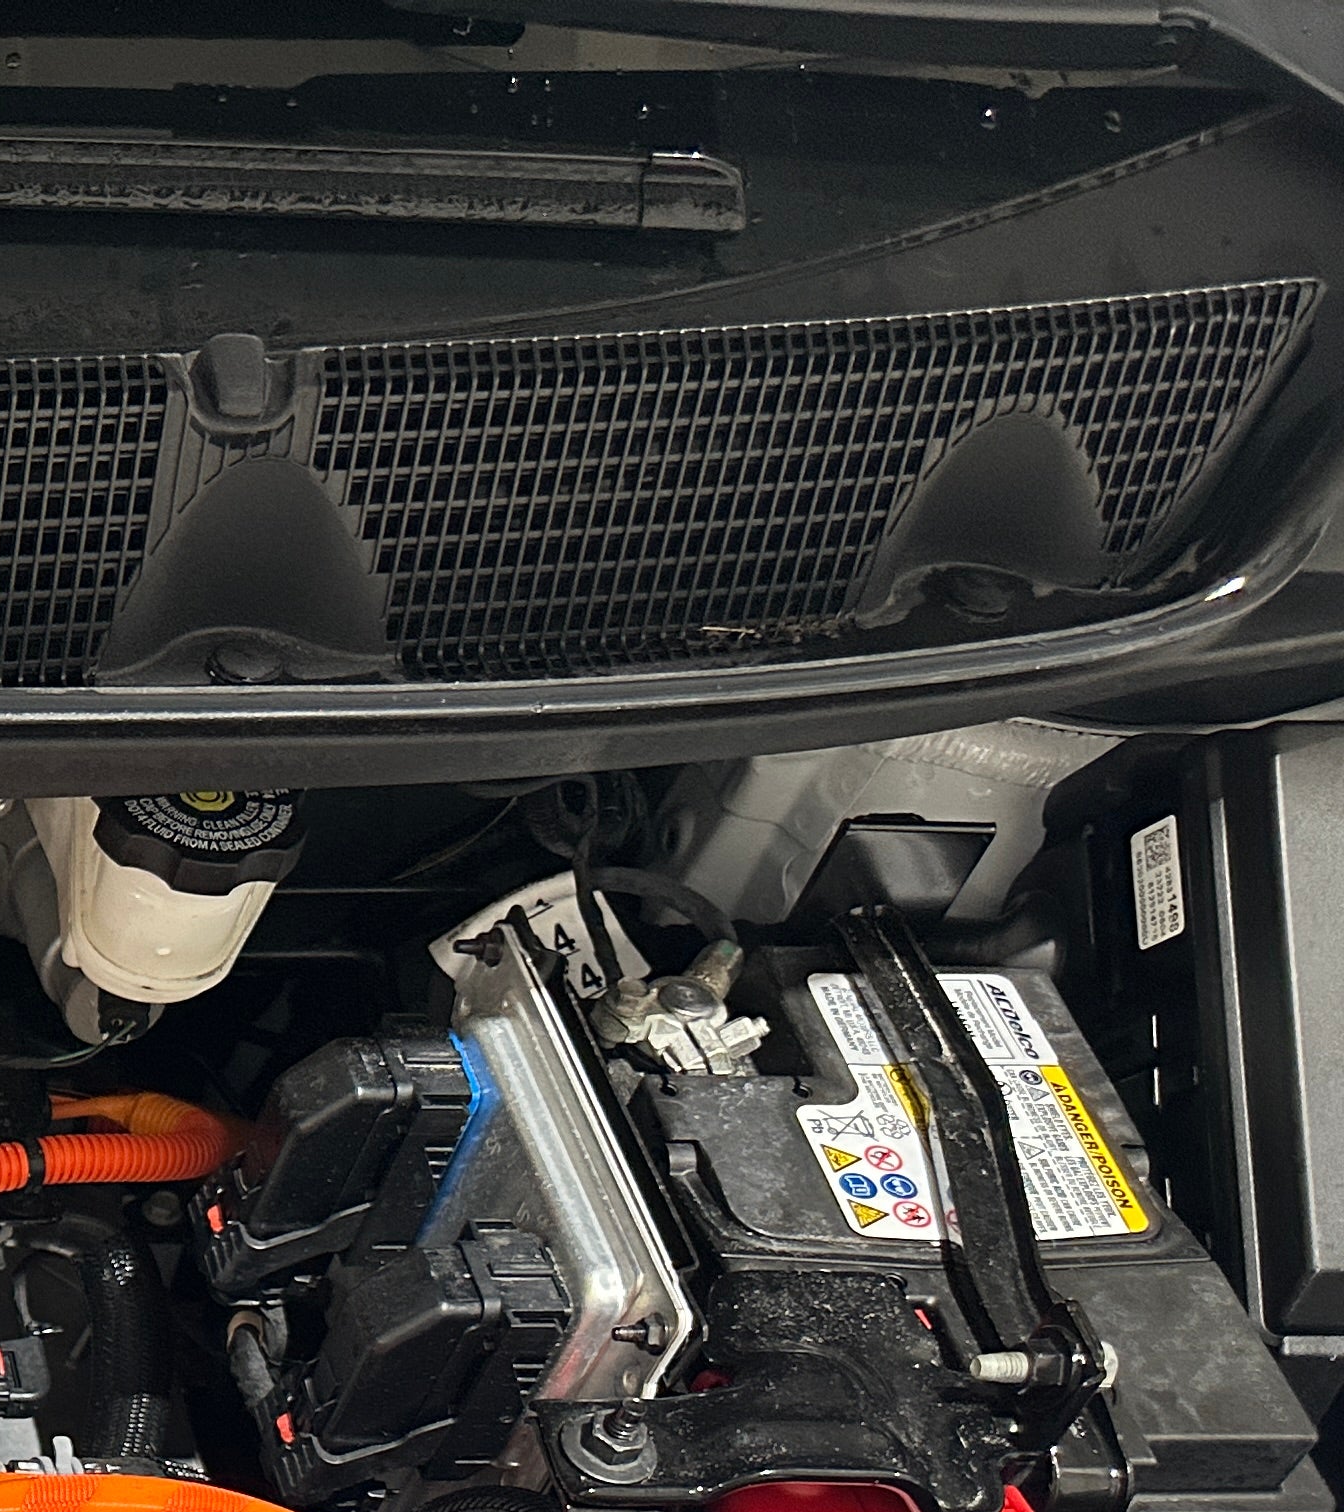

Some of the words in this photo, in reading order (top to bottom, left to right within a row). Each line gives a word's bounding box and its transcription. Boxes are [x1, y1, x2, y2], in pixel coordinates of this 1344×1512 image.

[145, 817, 174, 839] FLUID
[173, 833, 211, 850] FROM
[211, 841, 219, 851] A
[221, 838, 262, 851] SEALED
[261, 803, 293, 842] CONTAINER
[154, 813, 194, 836] BEFORE
[203, 819, 239, 830] CLEAN
[554, 923, 576, 951] 4
[581, 963, 603, 989] 4
[821, 986, 836, 1007] MADE
[834, 1017, 858, 1051] GERMANY
[985, 984, 1040, 1059] ACDelco
[1055, 1094, 1133, 1209] DANGER/POISON
